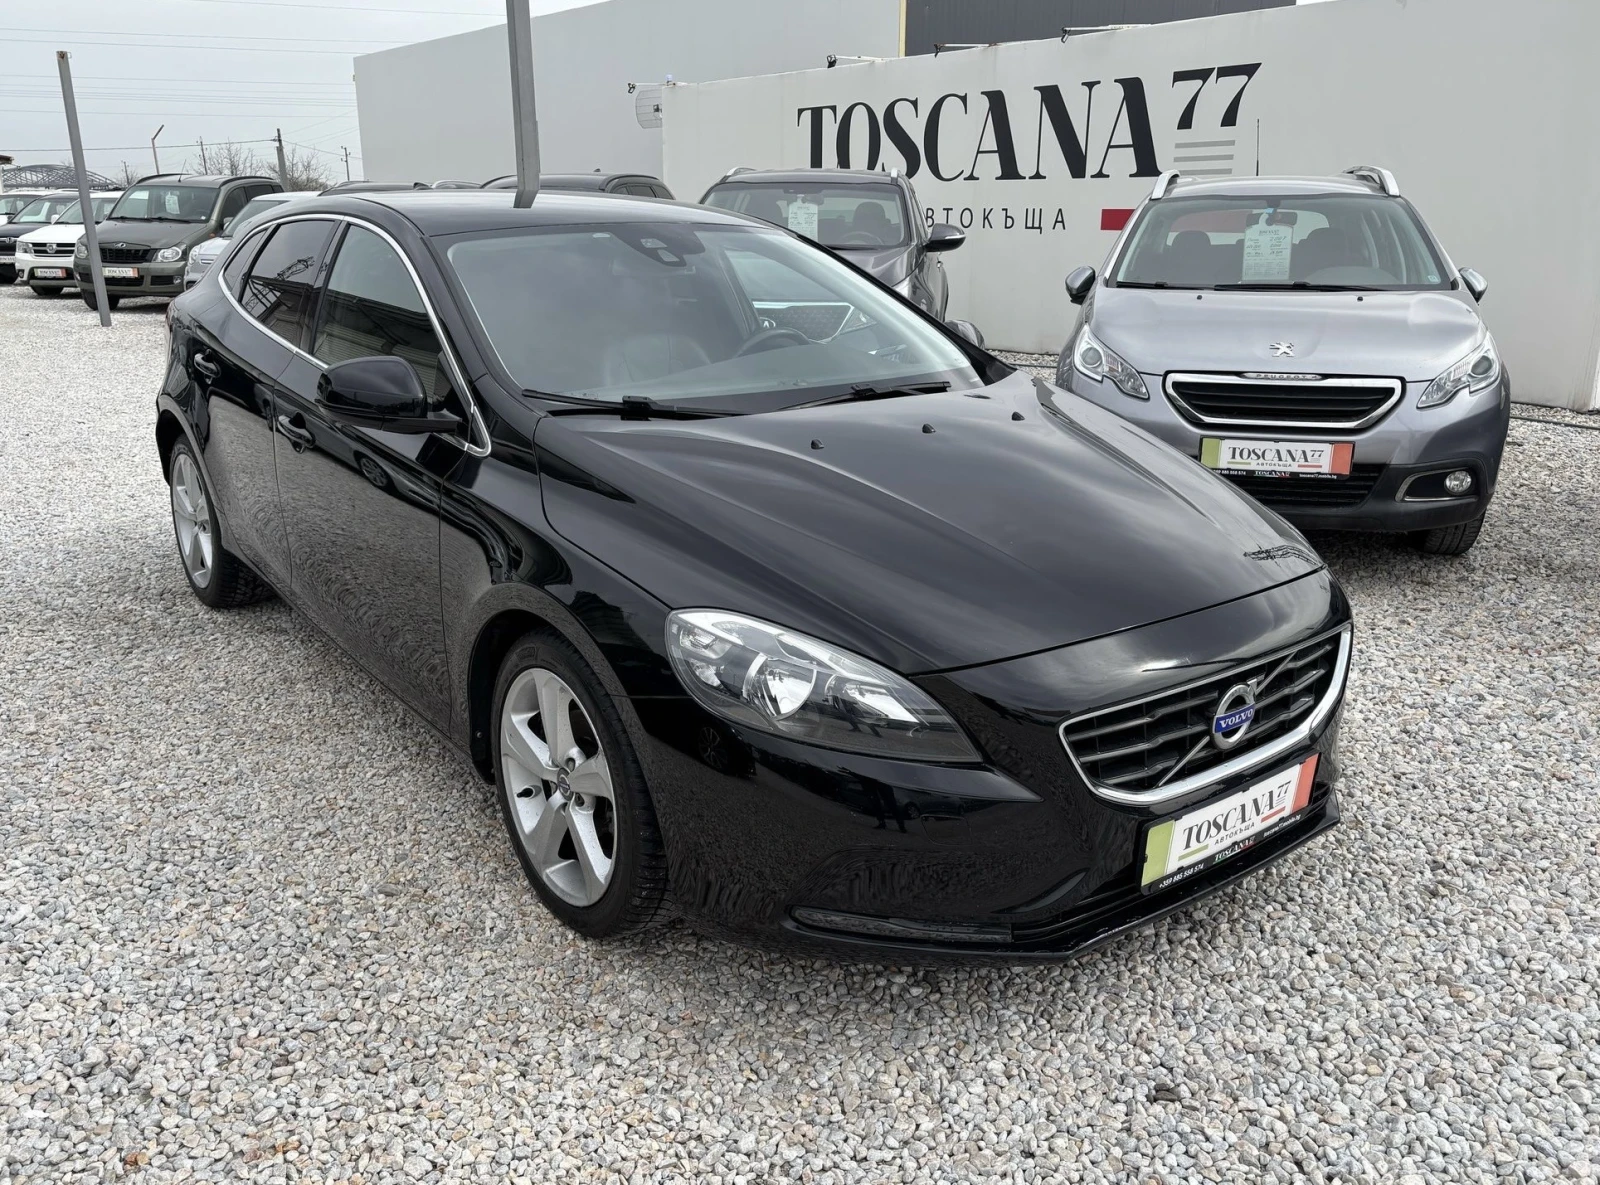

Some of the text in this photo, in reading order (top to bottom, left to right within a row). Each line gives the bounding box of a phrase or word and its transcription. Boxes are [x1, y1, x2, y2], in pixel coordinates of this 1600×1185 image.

[925, 207, 1066, 234] ВТОКЪЩА
[1219, 708, 1253, 728] VOLVO
[1214, 822, 1255, 845] АВТОКЪЩА
[1159, 877, 1173, 888] +359
